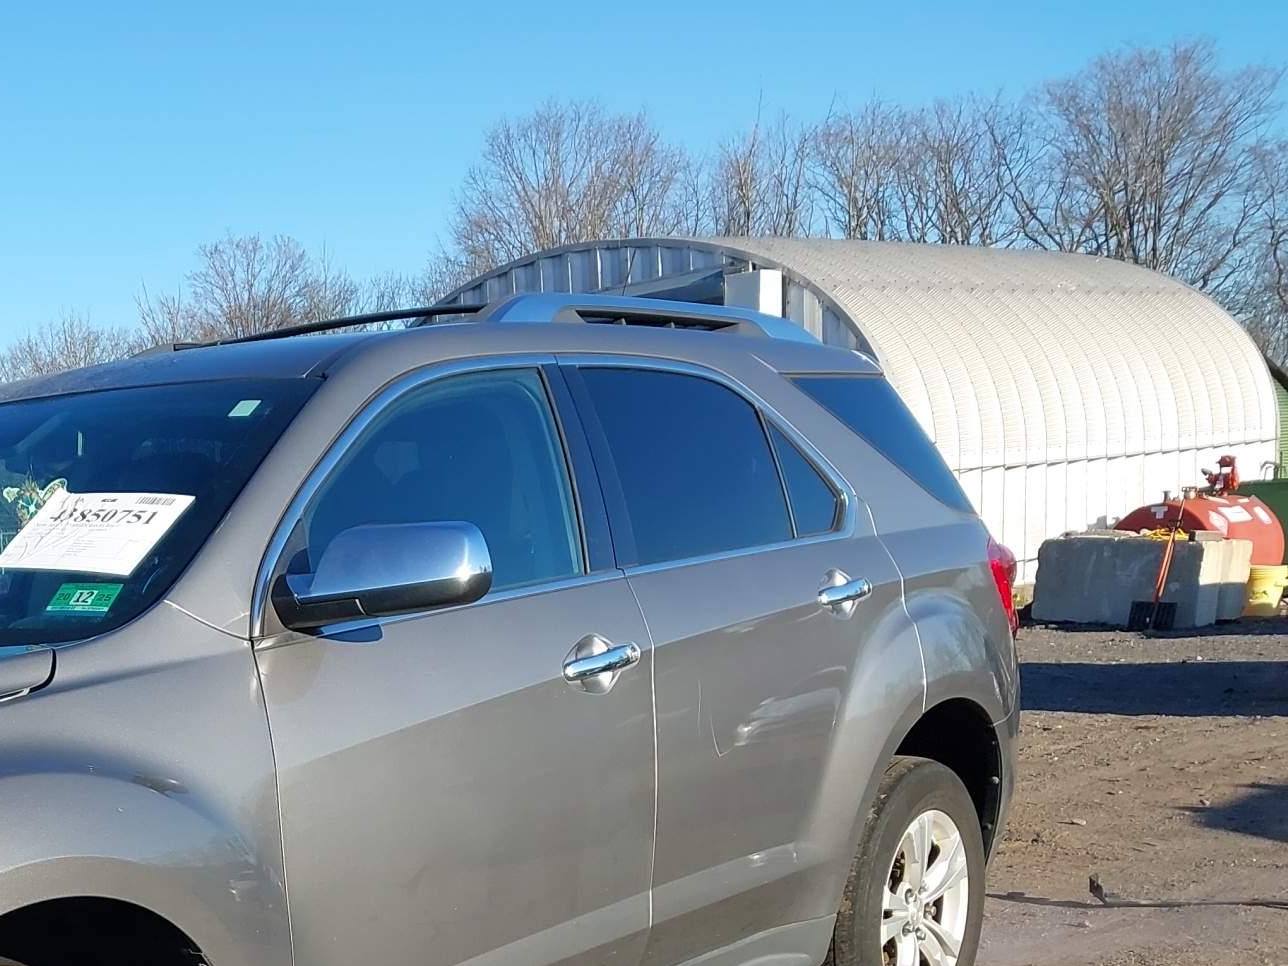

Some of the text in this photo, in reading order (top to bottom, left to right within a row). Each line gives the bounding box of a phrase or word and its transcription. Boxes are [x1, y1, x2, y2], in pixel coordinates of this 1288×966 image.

[49, 508, 159, 525] 43850751
[56, 591, 112, 603] 20 12 25
